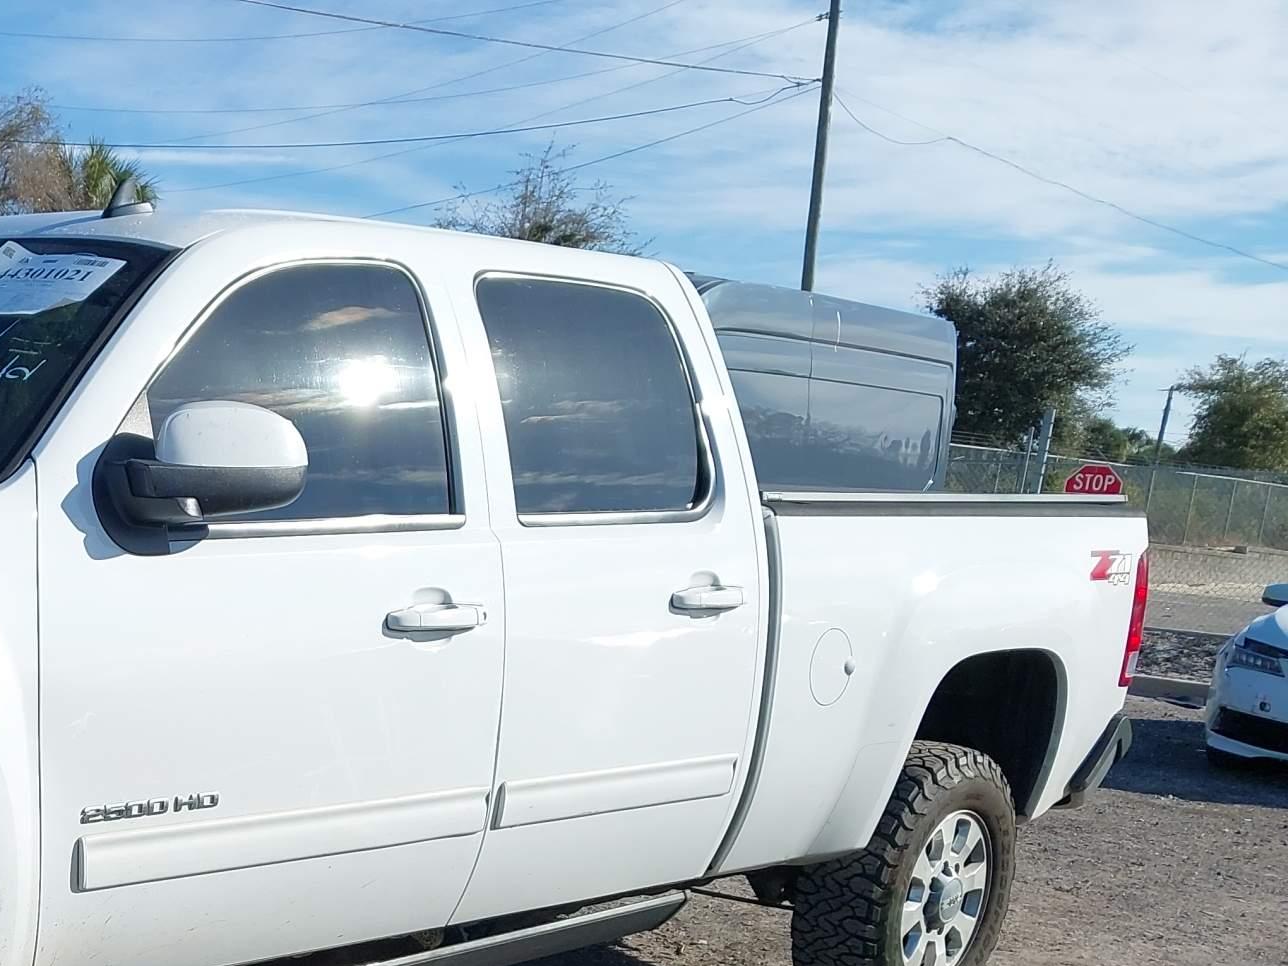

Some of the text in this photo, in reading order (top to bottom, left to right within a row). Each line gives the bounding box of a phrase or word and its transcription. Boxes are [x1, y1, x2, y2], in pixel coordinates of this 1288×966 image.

[1073, 473, 1115, 491] STOP
[1090, 550, 1133, 581] Z71
[80, 791, 220, 825] 2500 HD
